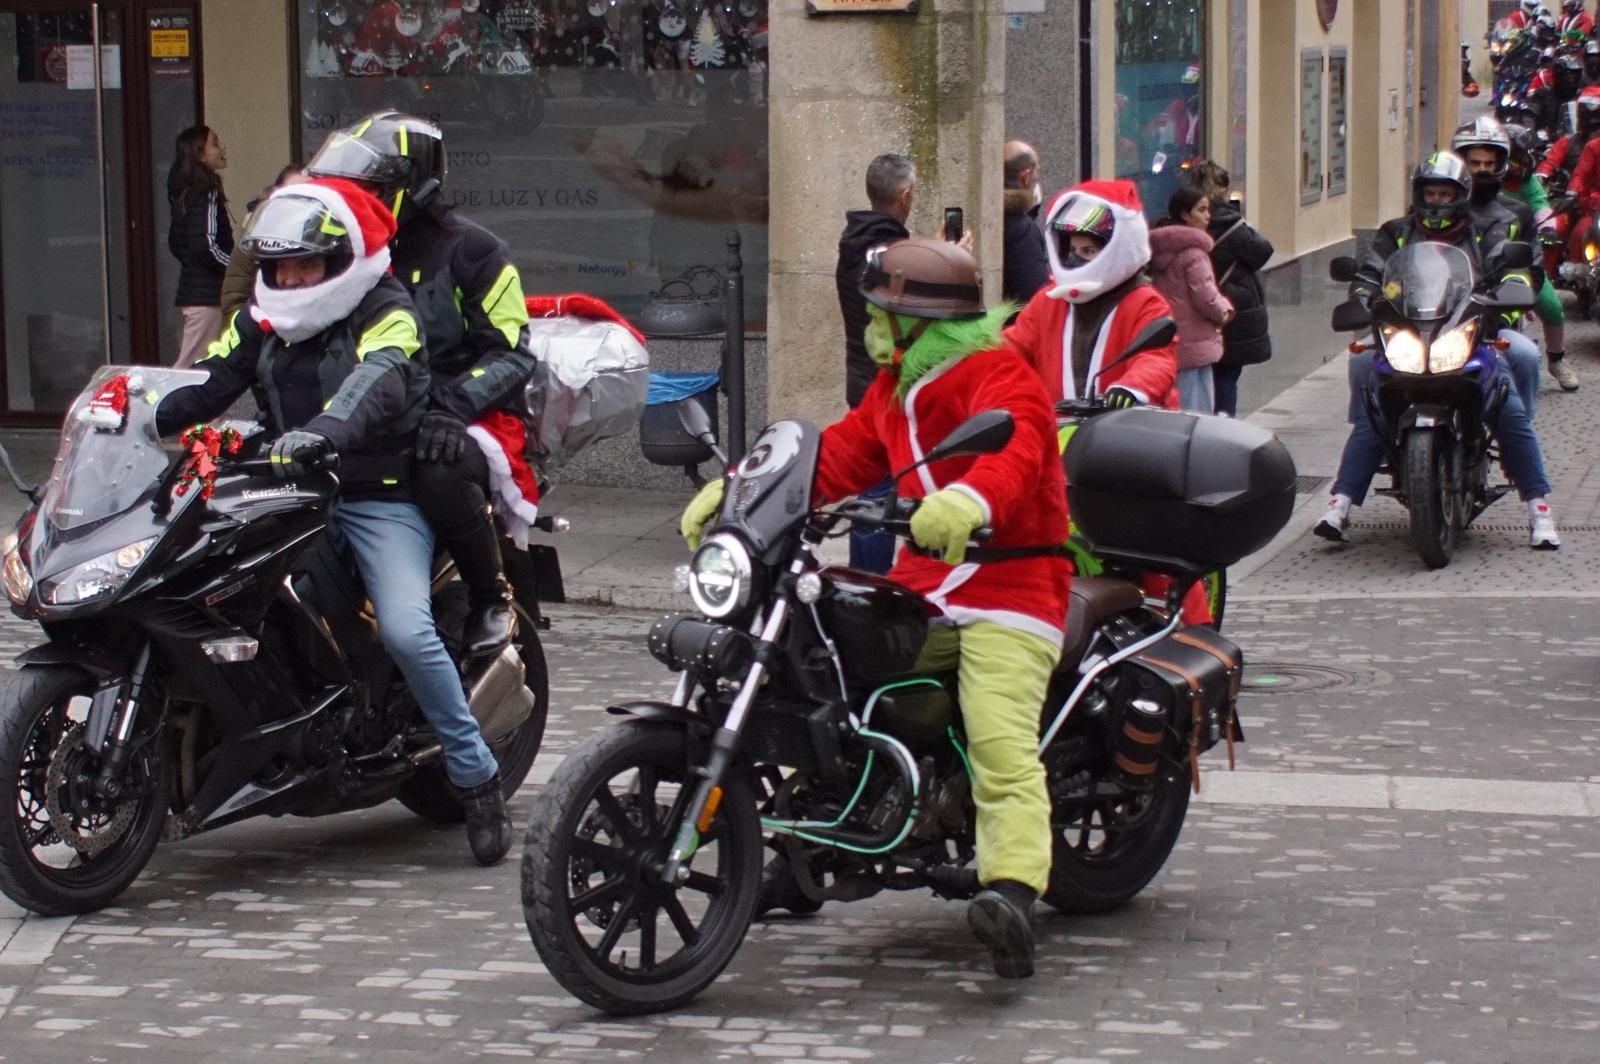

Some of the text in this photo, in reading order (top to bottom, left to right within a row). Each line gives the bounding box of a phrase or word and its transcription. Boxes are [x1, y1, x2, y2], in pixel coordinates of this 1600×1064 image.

[452, 190, 481, 206] DE
[488, 190, 528, 207] LUZ
[533, 190, 546, 206] Y
[553, 189, 598, 207] GAS
[577, 263, 626, 277] Naturgy
[242, 483, 298, 499] Kawasaki
